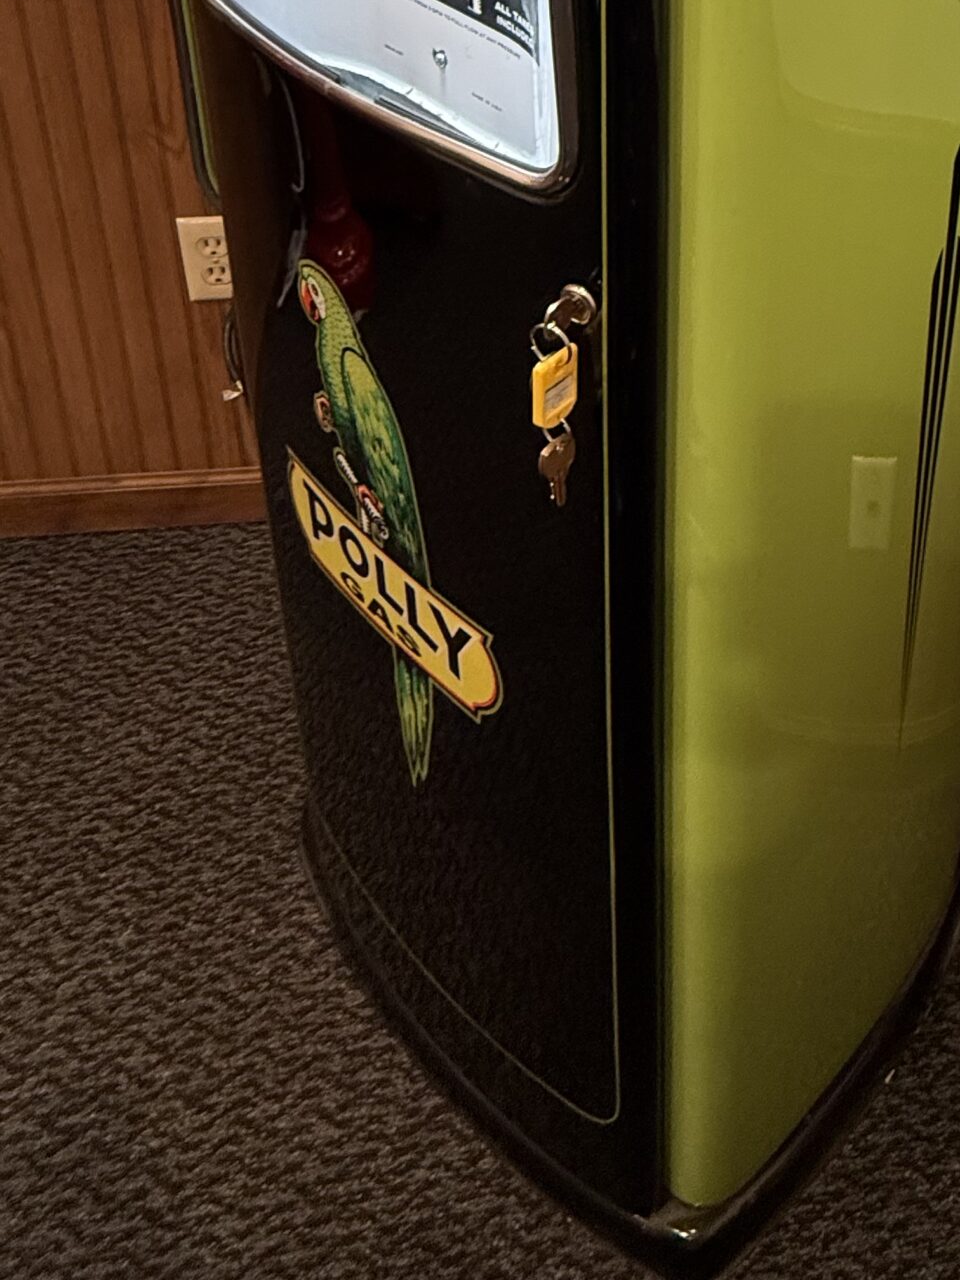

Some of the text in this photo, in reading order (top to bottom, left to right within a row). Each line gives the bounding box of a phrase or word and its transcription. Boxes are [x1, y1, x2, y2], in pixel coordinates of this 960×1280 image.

[494, 0, 513, 18] ALL
[303, 478, 471, 681] POLLY
[340, 571, 421, 658] GAS
